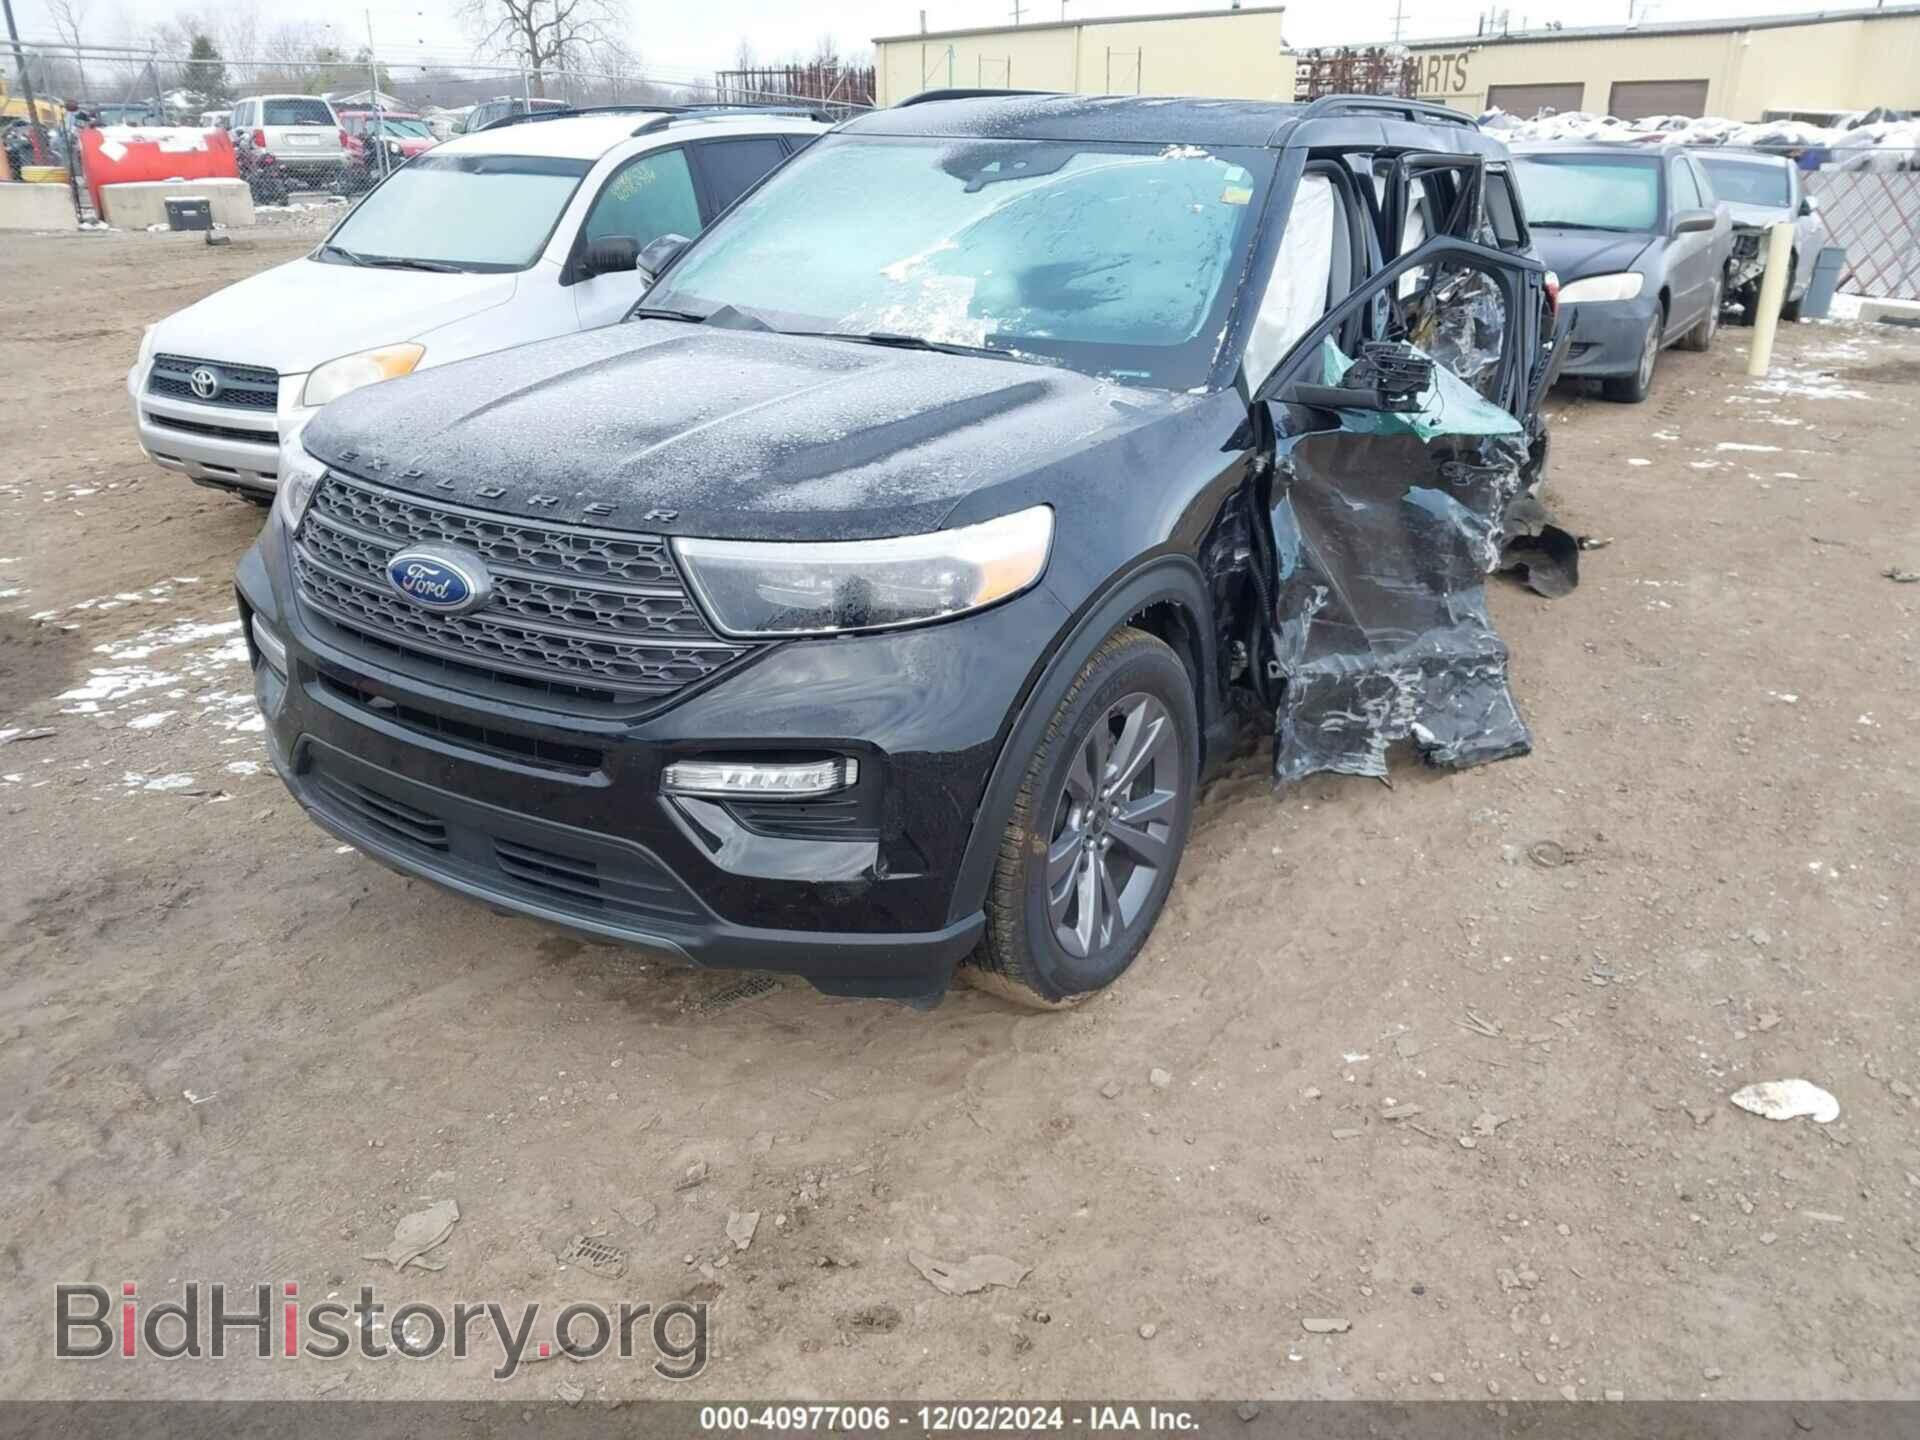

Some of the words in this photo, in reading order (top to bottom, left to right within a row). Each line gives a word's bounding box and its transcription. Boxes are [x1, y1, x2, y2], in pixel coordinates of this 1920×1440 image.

[1408, 53, 1469, 93] ARTS
[337, 450, 680, 523] EXPLORER
[402, 563, 451, 599] Ford
